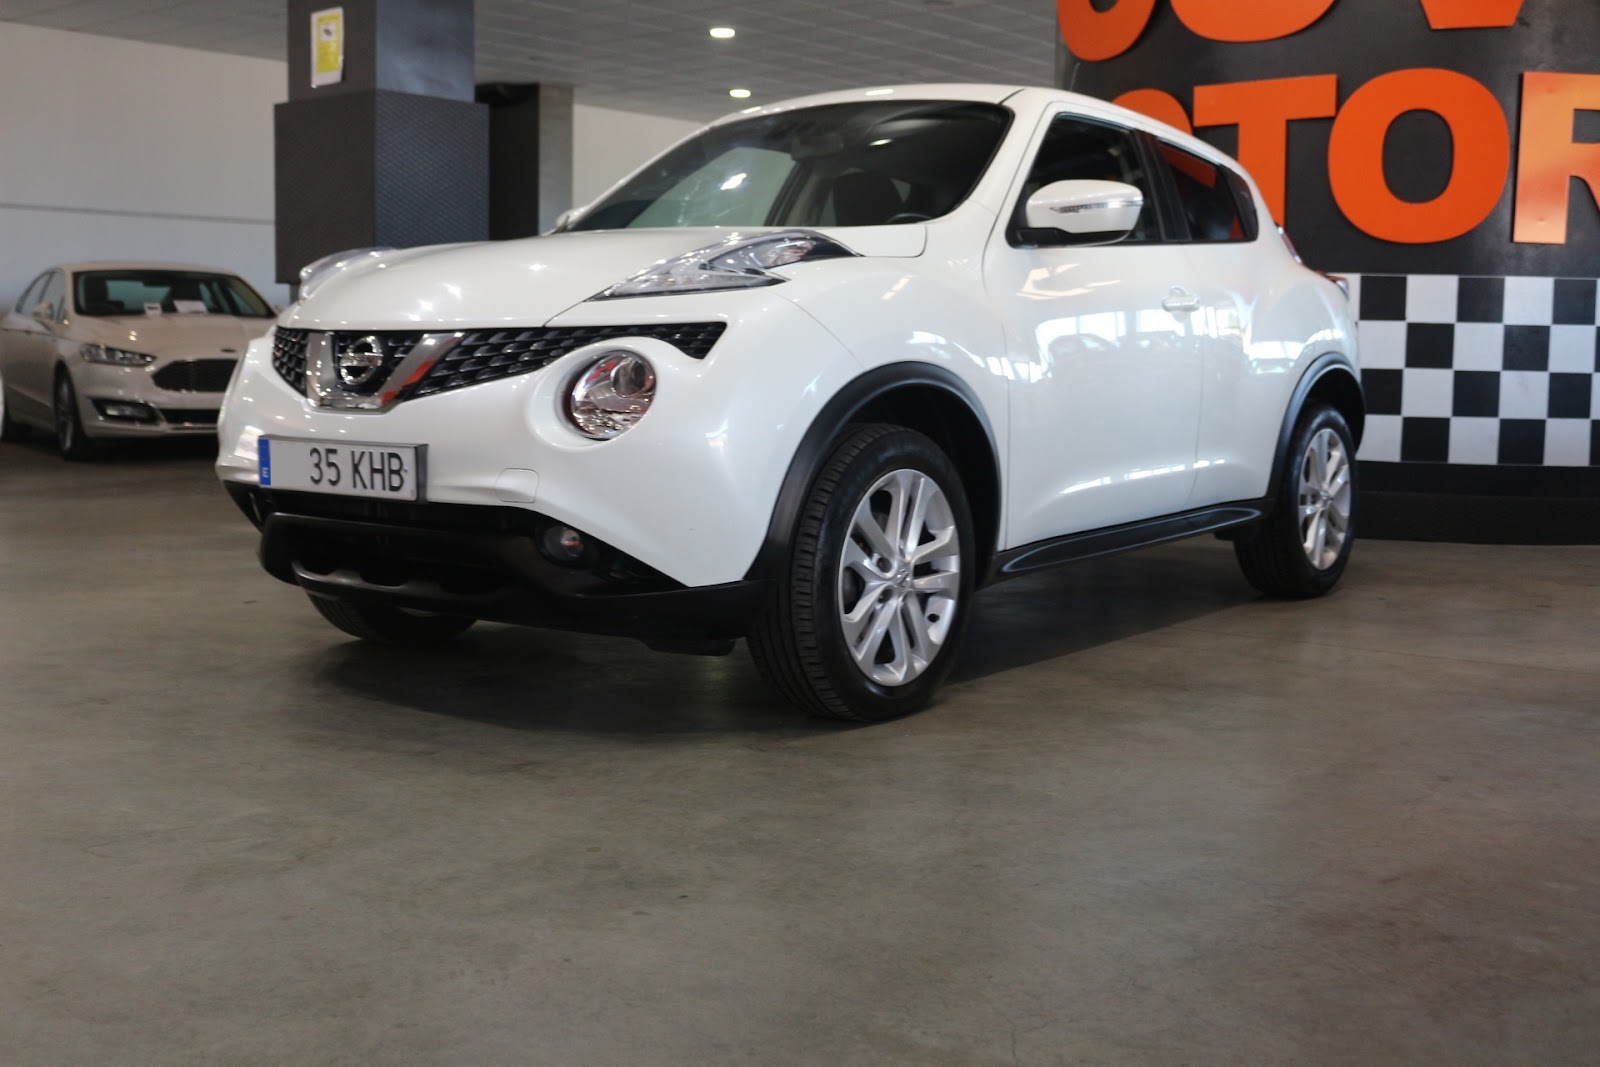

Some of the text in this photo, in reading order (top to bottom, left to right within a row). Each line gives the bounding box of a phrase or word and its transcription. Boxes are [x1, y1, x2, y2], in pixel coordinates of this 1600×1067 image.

[1109, 67, 1600, 245] TOR
[309, 447, 404, 492] 35 KHB
